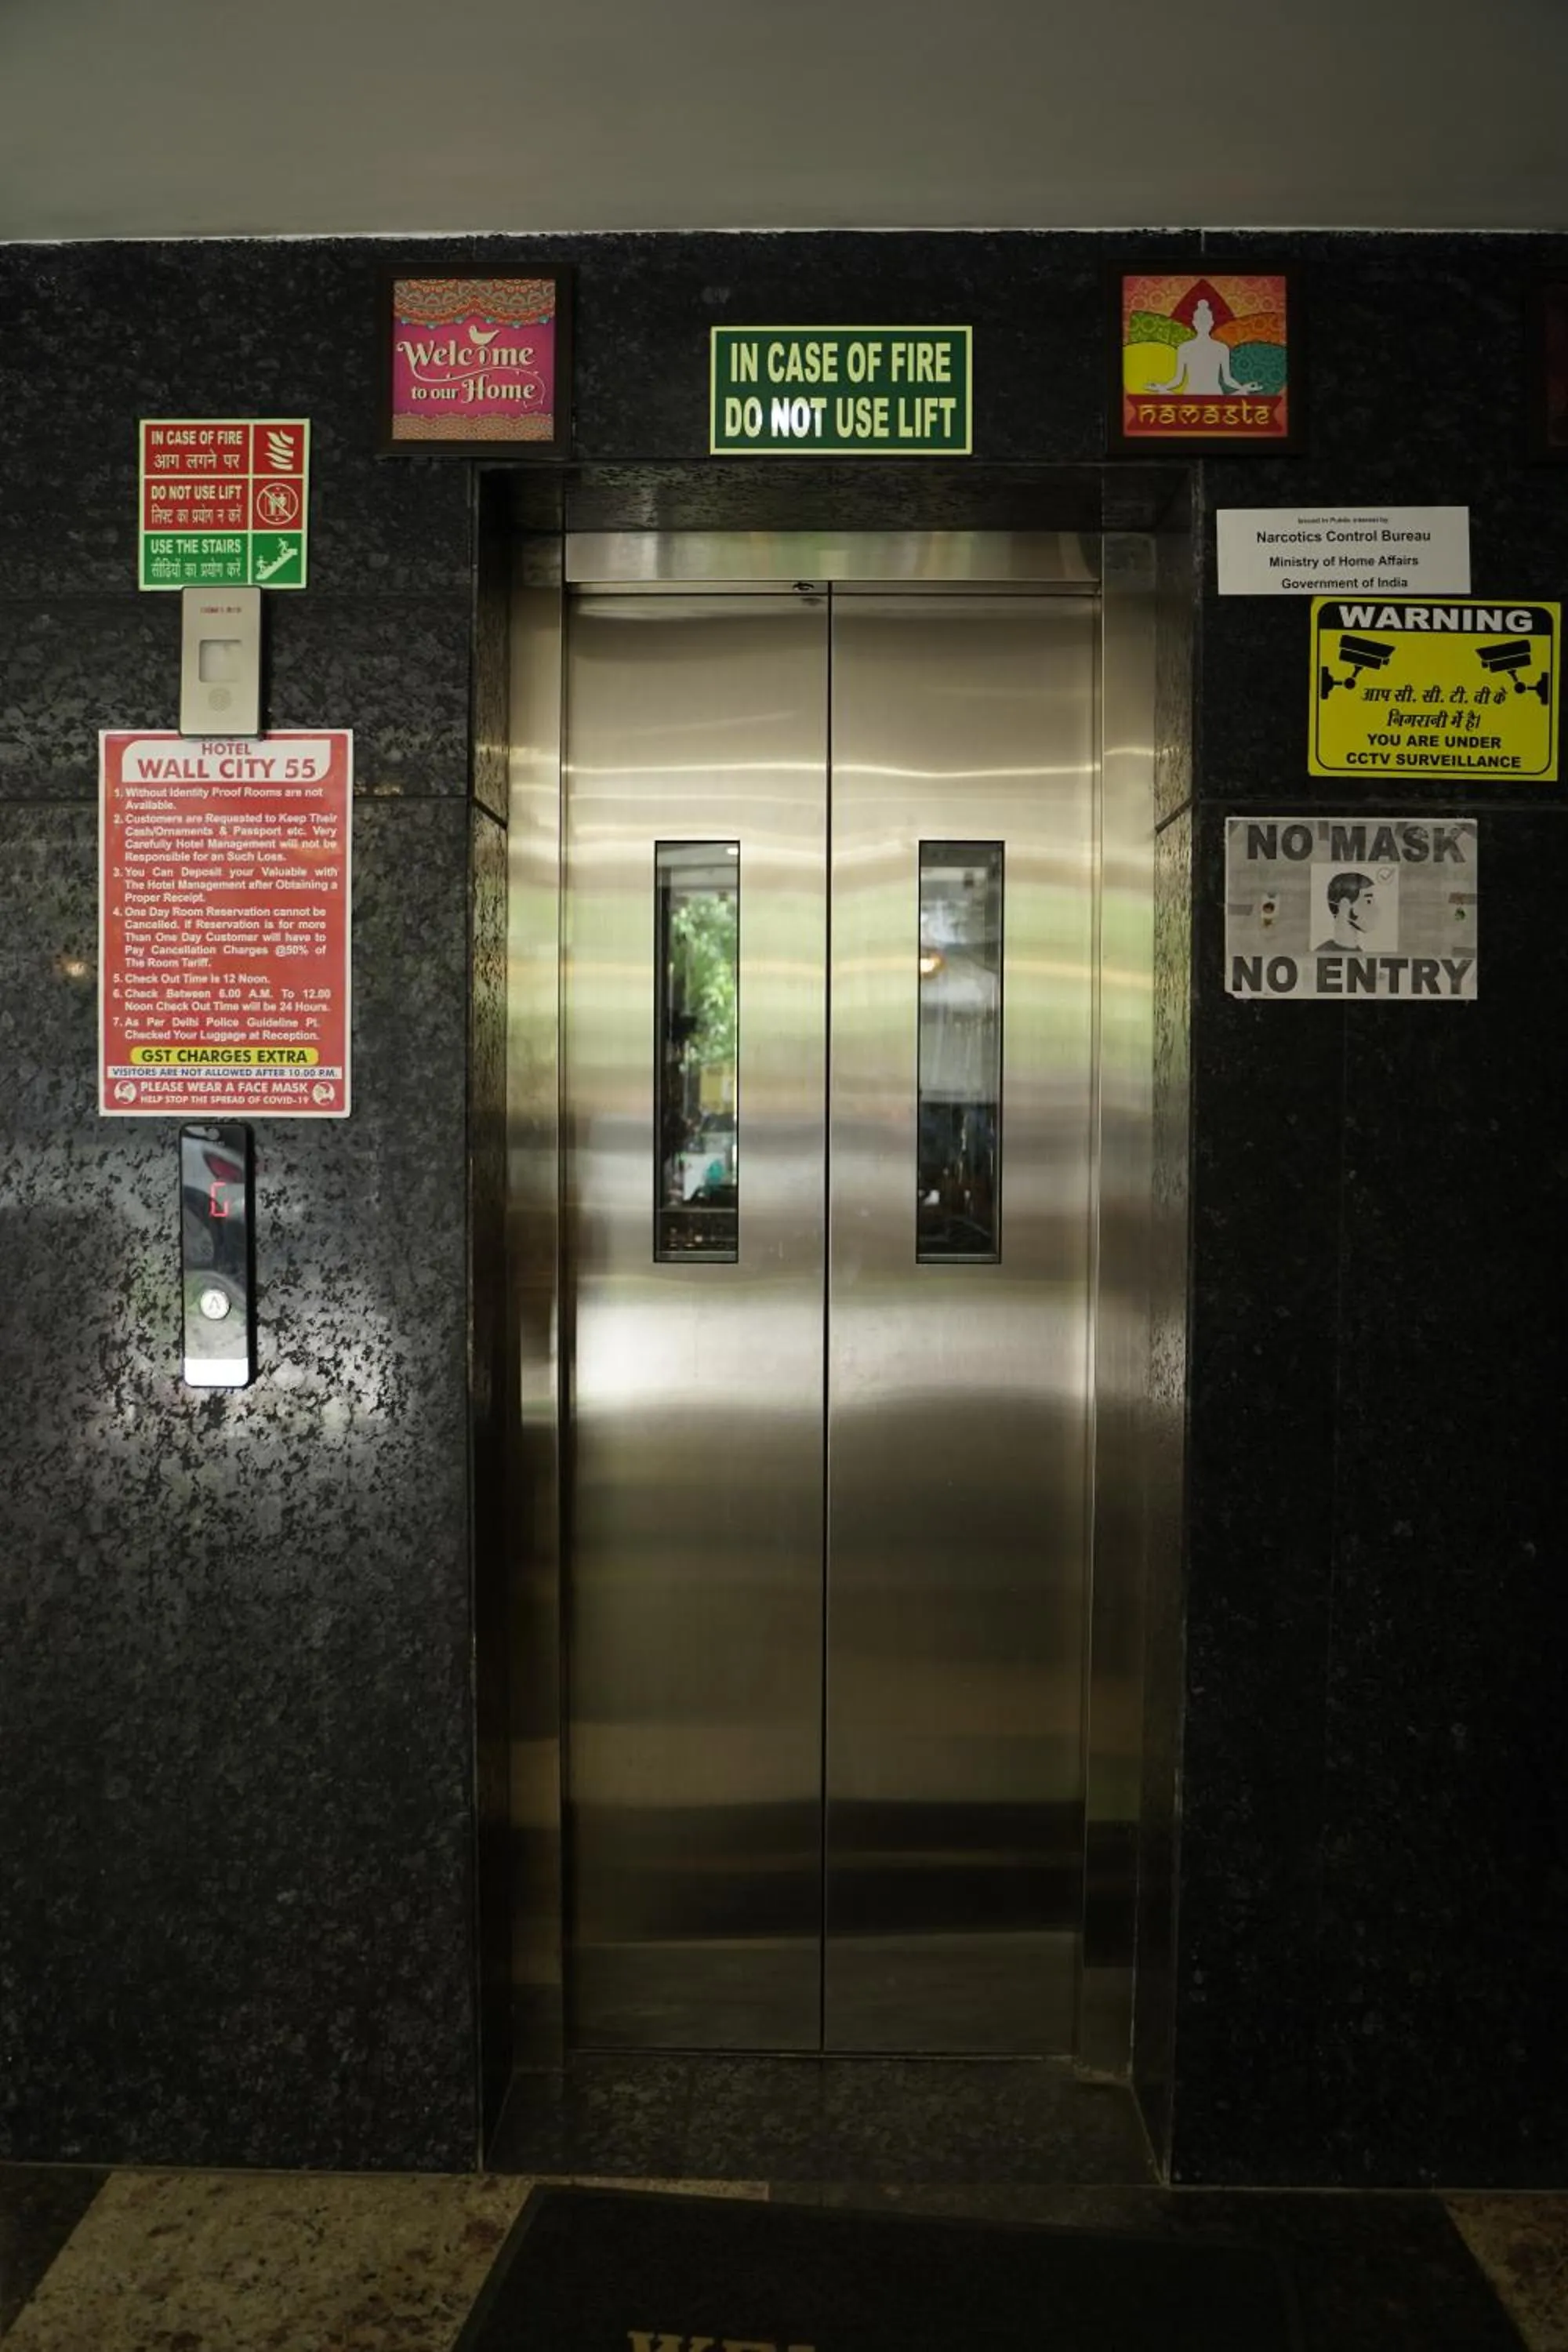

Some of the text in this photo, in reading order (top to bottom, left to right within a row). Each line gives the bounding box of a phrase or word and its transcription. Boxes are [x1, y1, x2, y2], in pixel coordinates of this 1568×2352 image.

[397, 339, 535, 367] Welcome
[731, 342, 951, 383] IN CASE OF FIRE
[412, 375, 535, 403] to our Home
[724, 397, 956, 438] DO NOT USE LIFT
[1138, 399, 1272, 425] namaste
[151, 430, 243, 445] IN CASE OF FIRE
[154, 448, 240, 470] आग लगने पर
[151, 485, 241, 499] DO NOT USE LIFT
[1257, 529, 1431, 544] Narcotics Control Bureau
[151, 539, 241, 554] USE THE STAIRS
[1269, 554, 1419, 569] Ministry of Home Affairs
[1281, 577, 1408, 590] Government of India
[1338, 604, 1534, 633] WARNING
[1361, 687, 1390, 702] आप
[1493, 686, 1508, 706] के
[201, 742, 252, 756] HOTEL
[1367, 734, 1501, 749] YOU ARE UNDER
[137, 759, 315, 779] WALL CITY 55
[1346, 752, 1521, 768] CCTV SURVEILLANCE
[1247, 824, 1466, 862] NO MASK
[1232, 956, 1472, 995] NO ENTRY
[141, 1050, 307, 1063] GST CHARGES EXTRA
[140, 1082, 308, 1092] PLEASE WEAR A FACE MASK
